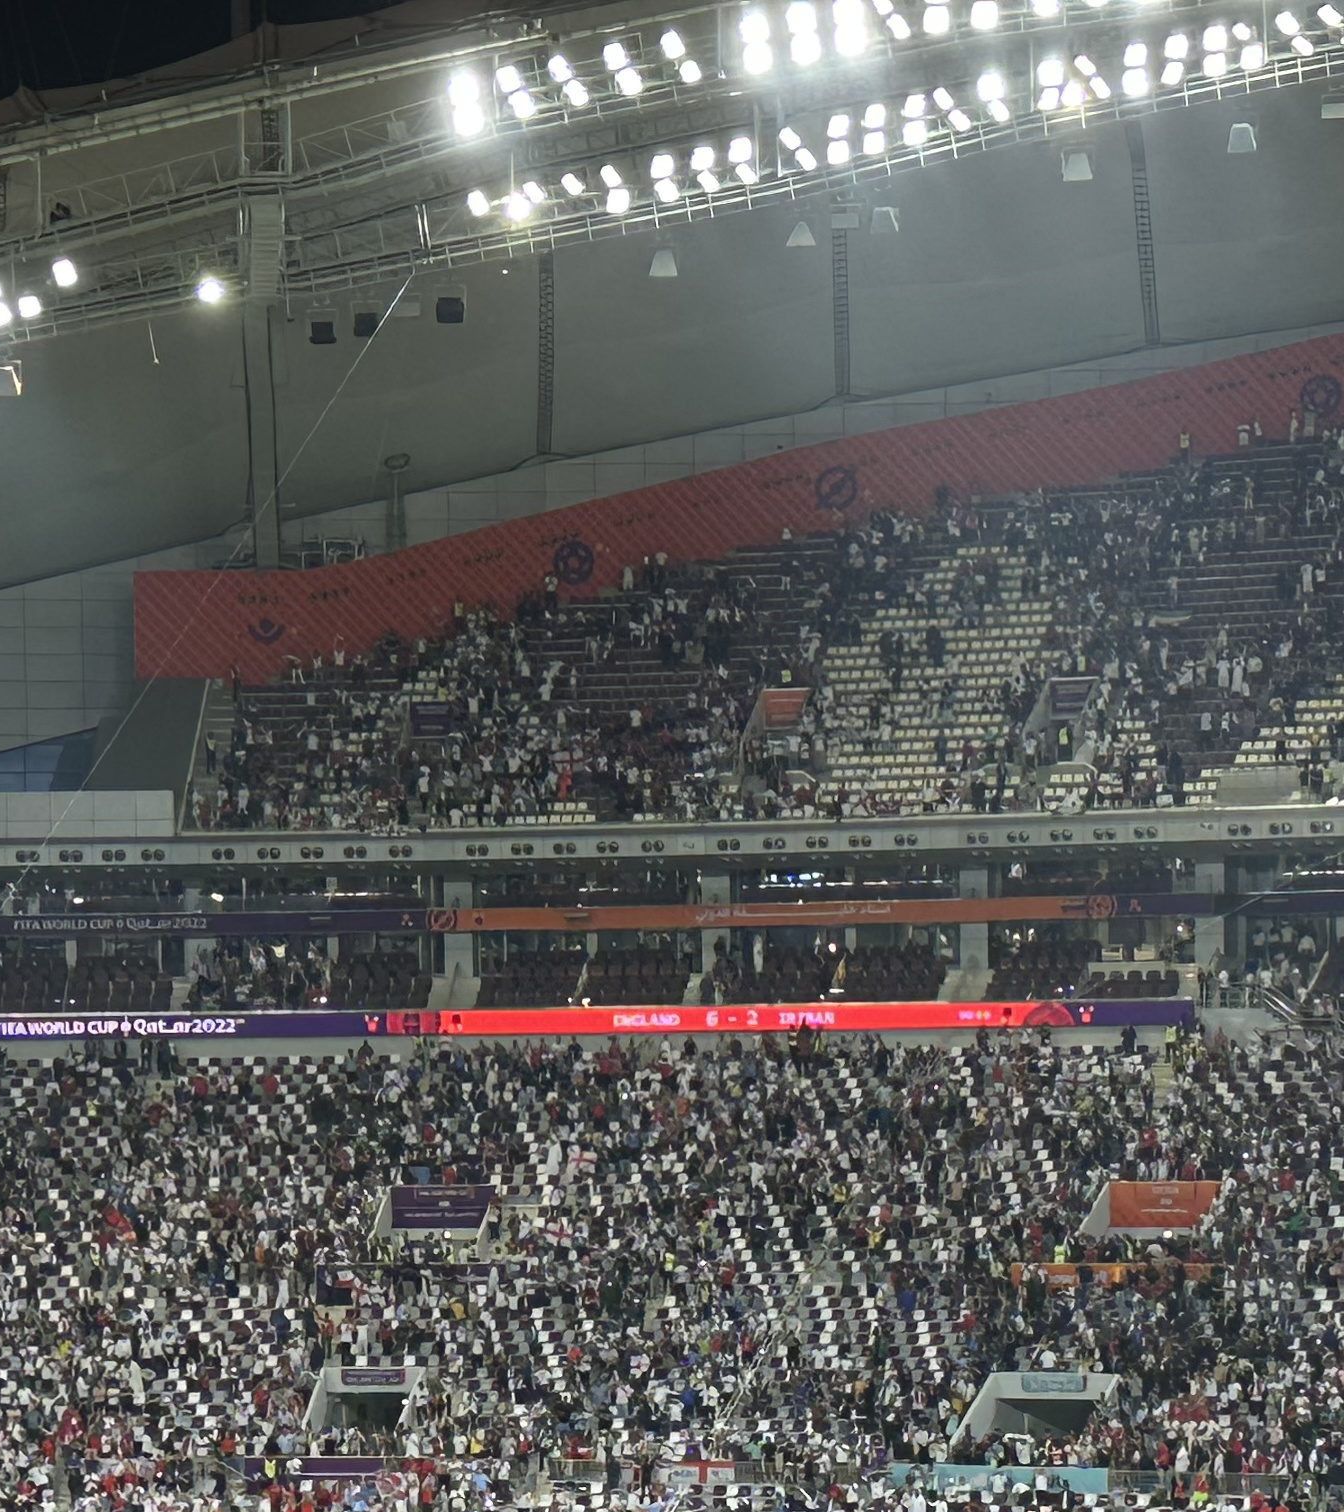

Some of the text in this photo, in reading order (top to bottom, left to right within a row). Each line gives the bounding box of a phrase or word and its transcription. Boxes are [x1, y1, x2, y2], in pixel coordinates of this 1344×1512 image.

[613, 1012, 681, 1027] ENGLAND
[706, 1010, 719, 1026] 6
[746, 1009, 758, 1025] 2
[26, 1020, 85, 1035] WORLD
[87, 1019, 119, 1035] CUP
